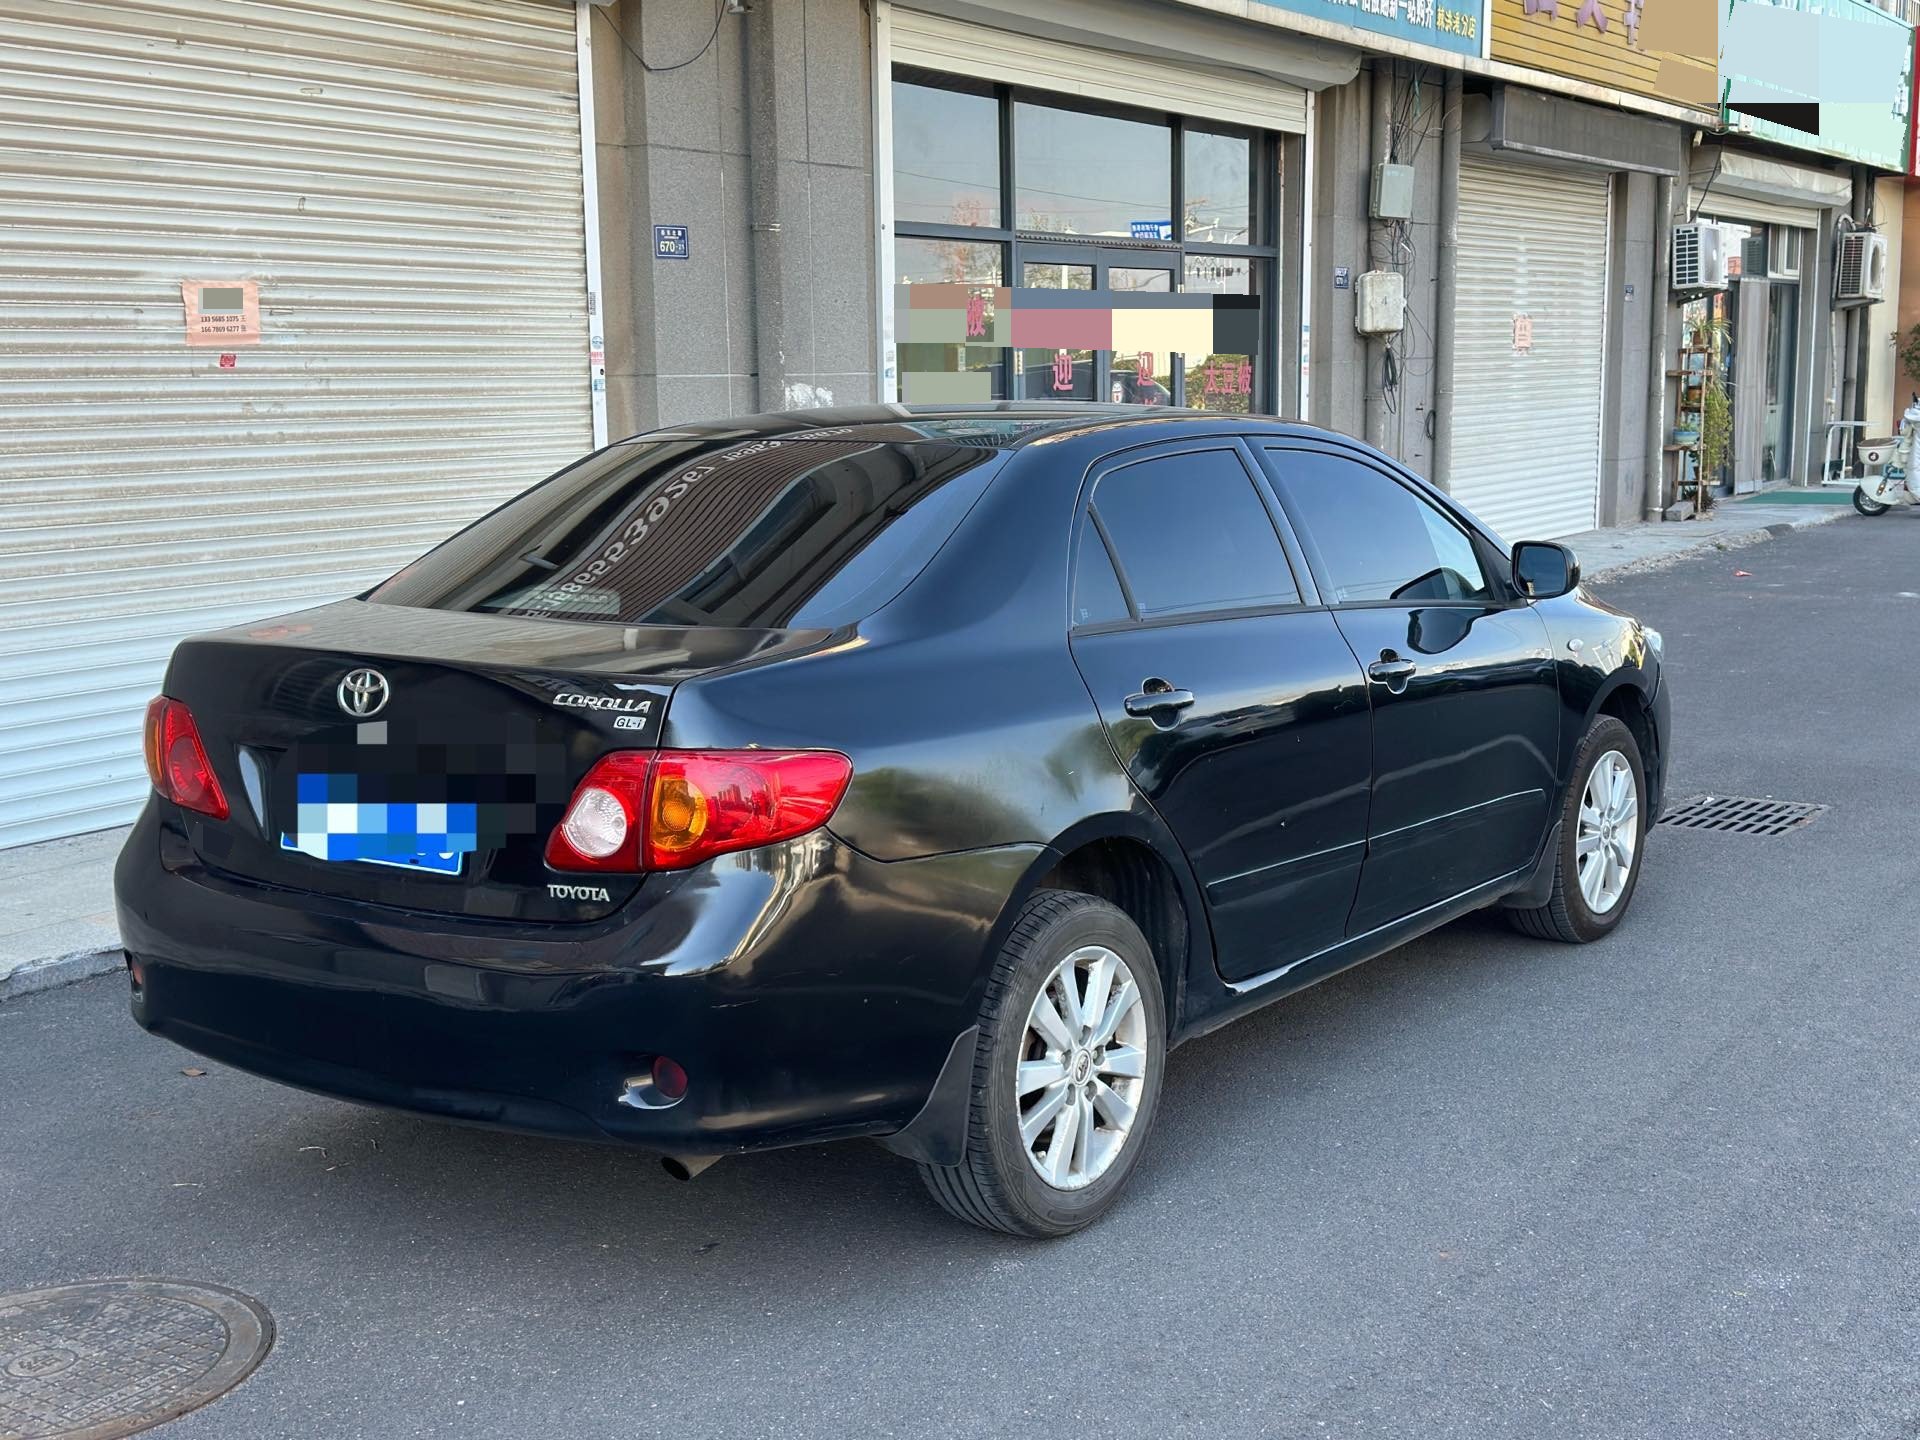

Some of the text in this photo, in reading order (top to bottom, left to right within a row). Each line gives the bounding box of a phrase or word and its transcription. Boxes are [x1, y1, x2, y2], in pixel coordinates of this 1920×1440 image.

[1053, 352, 1074, 391] 迎
[552, 693, 652, 713] COROLLA
[547, 884, 611, 902] TOYOTA
